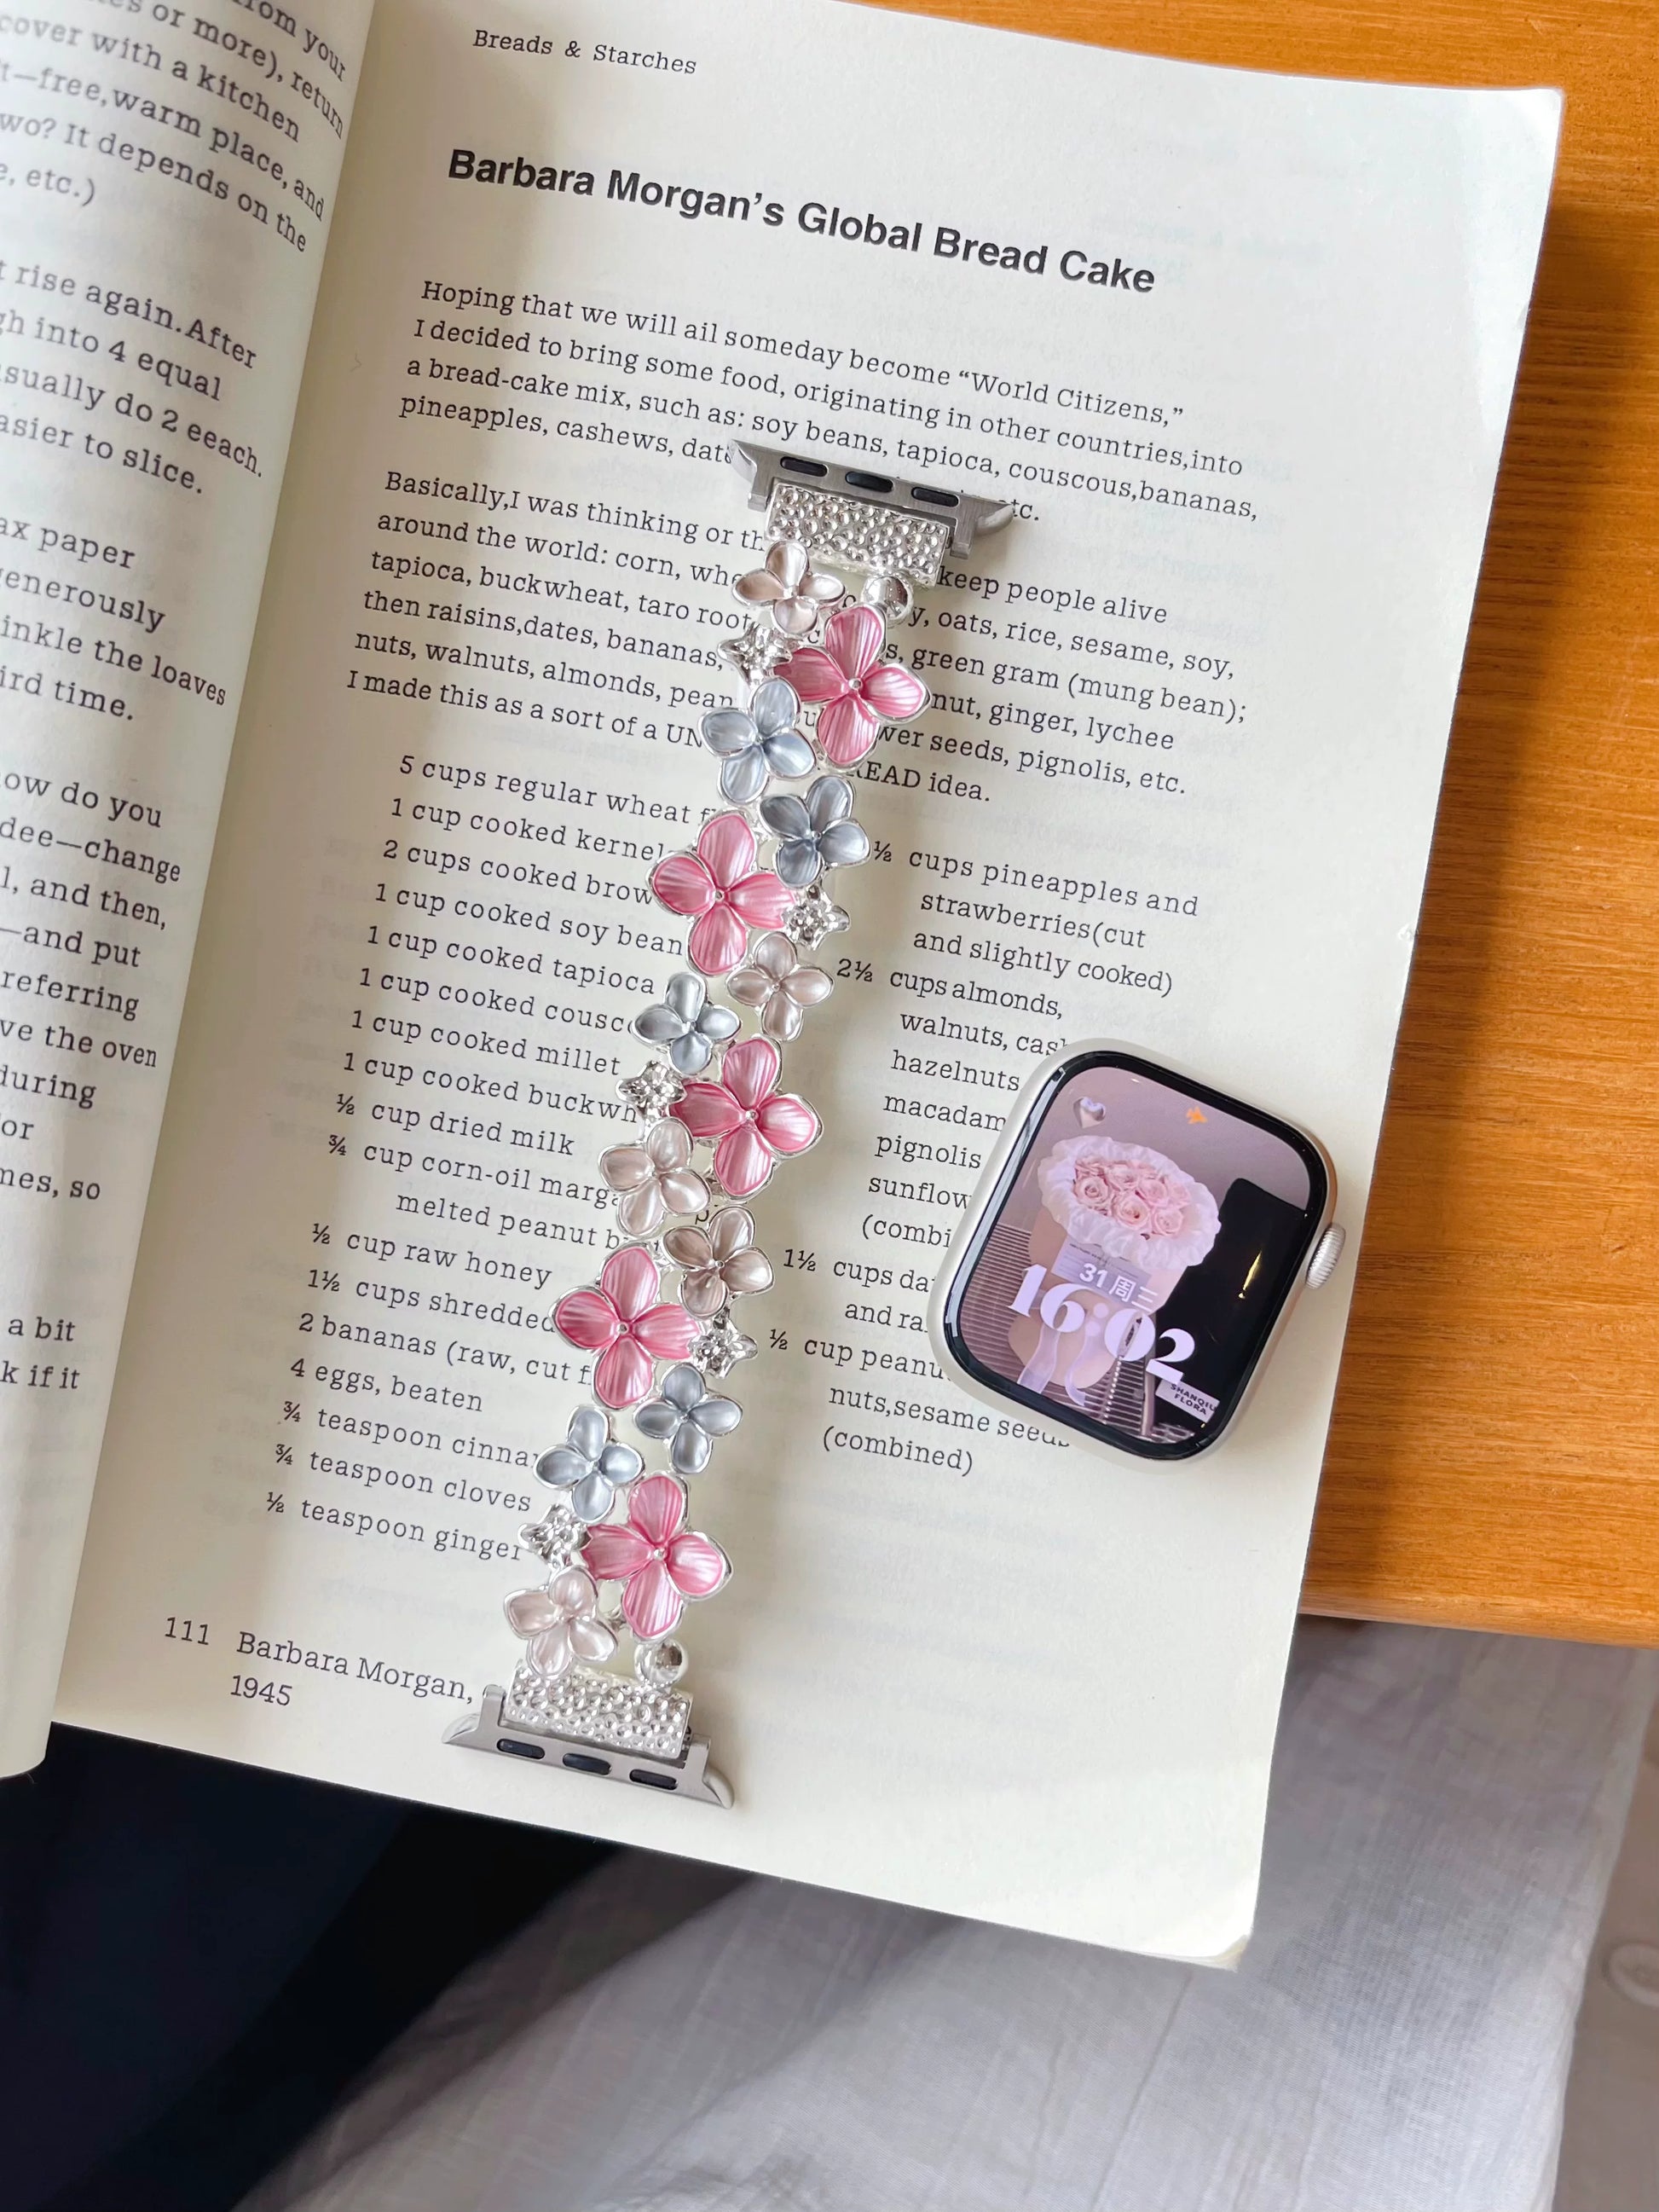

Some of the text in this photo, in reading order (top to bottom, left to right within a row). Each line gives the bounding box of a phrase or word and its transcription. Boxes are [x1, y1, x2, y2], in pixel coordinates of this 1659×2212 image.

[192, 16, 344, 141] more), return
[471, 29, 697, 74] Breads & Starches
[91, 31, 300, 144] with a kitchen
[65, 124, 307, 253] It depends on the
[448, 148, 1155, 293] Barbara Morgan’s Global Bread Cake
[15, 265, 76, 296] rise
[420, 280, 517, 316] Hoping
[521, 293, 575, 320] that
[581, 305, 617, 326] we
[625, 313, 677, 337] will
[724, 331, 845, 371] someday
[848, 348, 951, 386] become
[958, 369, 1049, 405] “World
[413, 318, 426, 339] I
[430, 320, 531, 353] decided
[539, 336, 563, 357] to
[569, 339, 640, 375] bring
[645, 356, 714, 382] some
[720, 365, 785, 399] food,
[794, 383, 941, 430] originating
[945, 407, 972, 431] in
[980, 417, 1051, 444] other
[114, 392, 262, 478] do 2 eeach.
[397, 395, 673, 458] pineapples, cashews,
[407, 359, 421, 377] a
[428, 357, 569, 397] bread-cake
[574, 384, 631, 412] mix,
[639, 395, 700, 420] such
[707, 407, 745, 428] as:
[751, 415, 800, 442] soy
[805, 420, 888, 458] beans,
[896, 438, 1000, 478] tapioca,
[377, 514, 680, 581] around the world: corn,
[371, 551, 690, 620] tapioca, buckwheat, taro
[936, 565, 1167, 623] keep people alive
[363, 589, 421, 617] then
[606, 628, 723, 672] bananas,
[938, 611, 998, 640] oats,
[1004, 622, 1062, 651] rice,
[1070, 634, 1174, 670] sesame,
[1182, 654, 1234, 680] soy,
[94, 640, 227, 706] the loaves
[346, 669, 657, 740] I made this as a sort of a
[910, 647, 986, 677] green
[991, 663, 1060, 690] gram
[1067, 672, 1154, 710] (mung
[1159, 686, 1247, 725] bean);
[988, 702, 1174, 750] ginger, lychee
[399, 755, 691, 825] 5 cups regular wheat
[927, 771, 990, 802] idea.
[929, 734, 1185, 794] seeds, pignolis, etc.
[30, 878, 166, 931] and then,
[909, 851, 1199, 917] cups pineapples and
[367, 924, 655, 995] 1 cup cooked tapioca
[913, 932, 1172, 999] and slightly cooked)
[889, 971, 948, 999] cups
[951, 980, 1062, 1021] almonds,
[44, 1025, 157, 1068] the oven
[371, 1103, 421, 1132] cup
[429, 1110, 502, 1143] dried
[509, 1129, 575, 1156] milk
[874, 1134, 982, 1169] pignolis
[363, 1145, 413, 1173] cup
[421, 1155, 531, 1190] corn-oil
[346, 1234, 396, 1262] cup
[403, 1244, 459, 1268] raw
[464, 1250, 553, 1291] honey
[8, 1316, 76, 1342] a bit
[298, 1312, 571, 1381] 2 bananas (raw, cut
[804, 1339, 853, 1368] cup
[1008, 1264, 1195, 1385] 16:02
[290, 1358, 483, 1412] 4 eggs, beaten
[1174, 1393, 1207, 1416] FLORA
[309, 1451, 434, 1494] teaspoon
[443, 1479, 531, 1512] cloves
[823, 1425, 973, 1478] (combined)
[301, 1499, 425, 1543] teaspoon
[164, 1616, 472, 1705] 111 Barbara Morgan,
[229, 1674, 293, 1706] 1945
